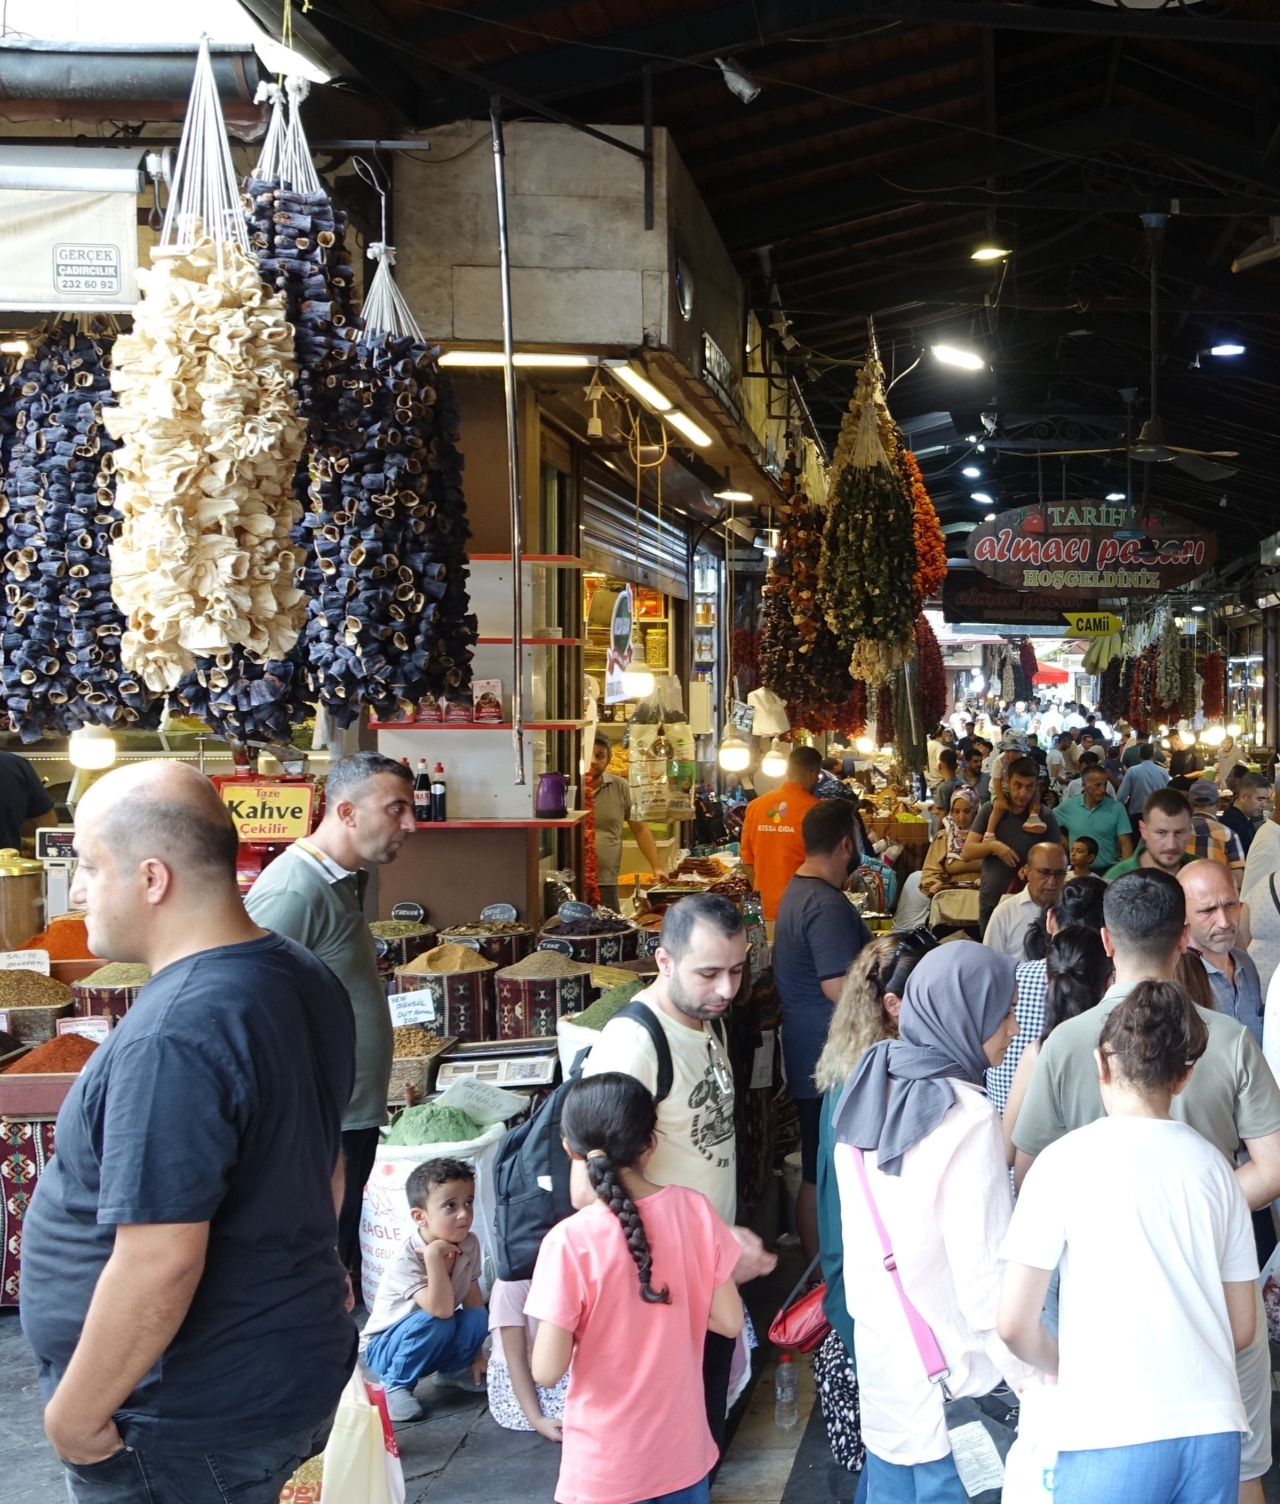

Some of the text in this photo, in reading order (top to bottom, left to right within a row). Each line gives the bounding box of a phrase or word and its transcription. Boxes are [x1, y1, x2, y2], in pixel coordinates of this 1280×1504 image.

[59, 249, 113, 264] GERÇEK
[58, 265, 116, 277] ÇADIRCILIK
[62, 280, 114, 289] 232 60 92
[974, 528, 1091, 566] almacı
[1022, 567, 1160, 589] HOŞGELDİNİZ
[255, 788, 281, 798] Taze
[228, 799, 304, 820] Kahve
[239, 823, 289, 837] Çekilir
[778, 825, 795, 833] GIDA
[397, 1010, 414, 1019] DUT
[362, 1219, 402, 1241] EAGLE
